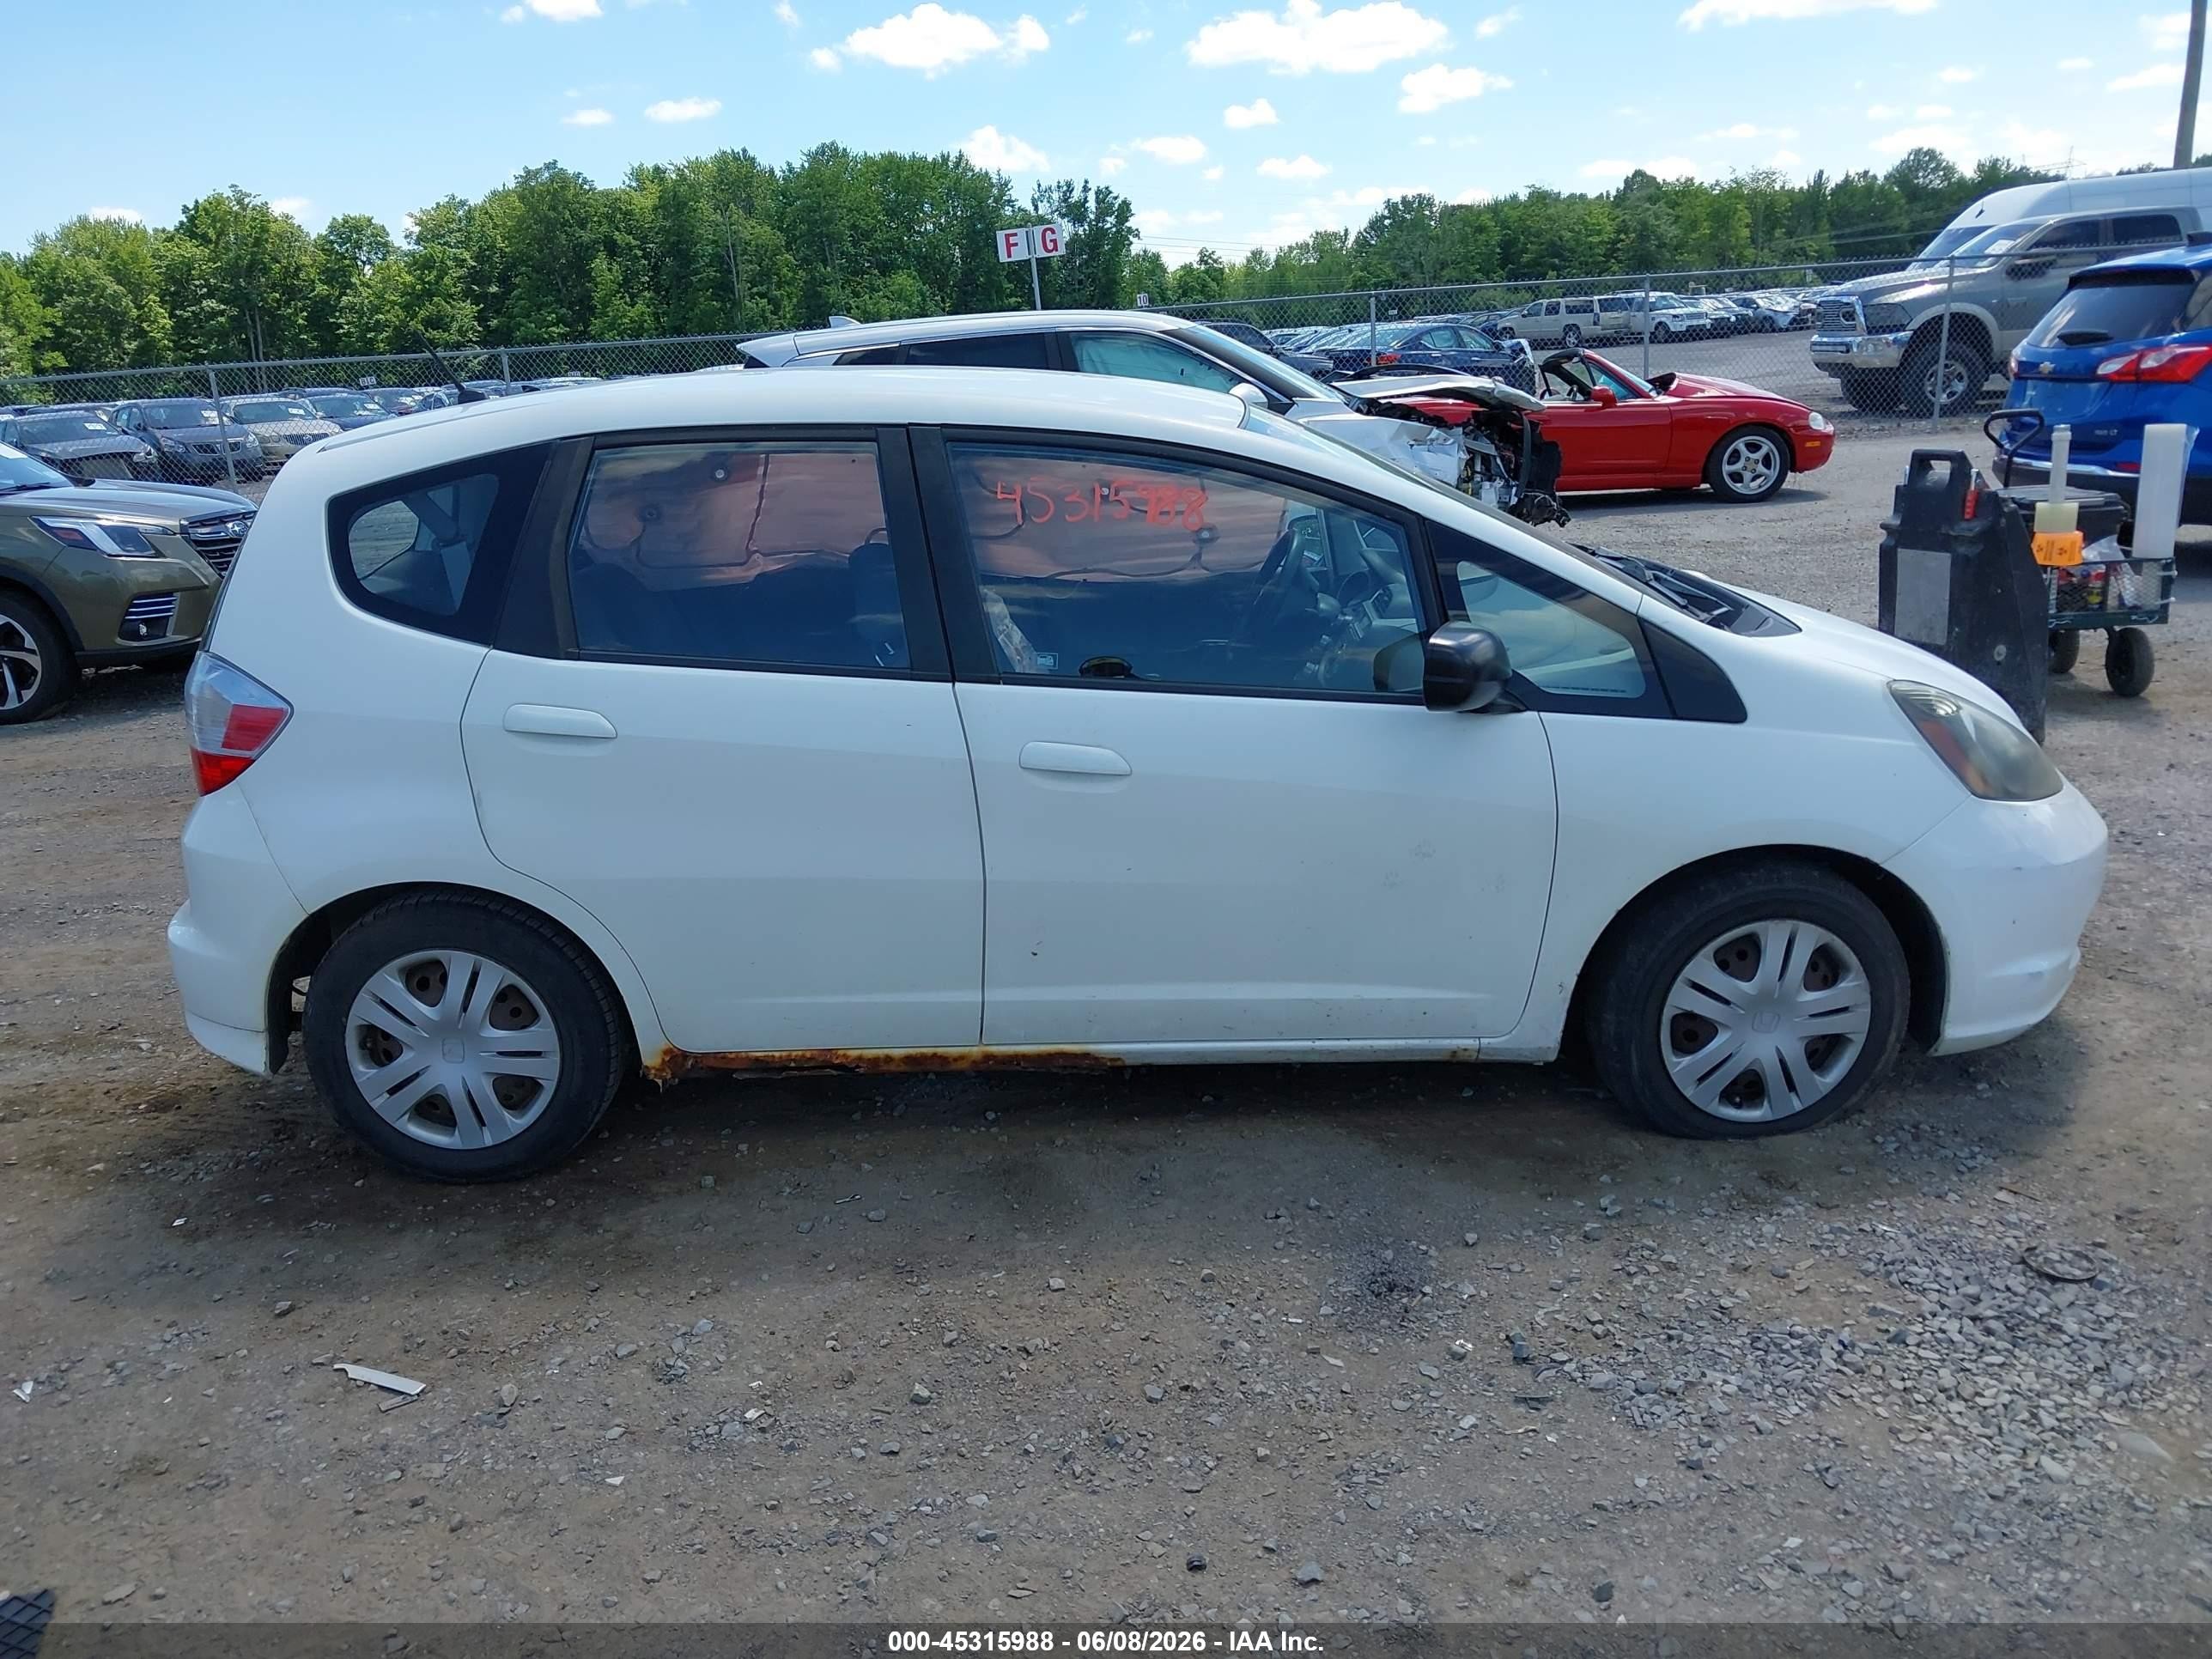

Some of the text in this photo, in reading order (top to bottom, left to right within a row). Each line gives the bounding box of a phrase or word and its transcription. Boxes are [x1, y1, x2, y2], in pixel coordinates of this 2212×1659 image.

[1004, 227, 1059, 258] F G
[1138, 295, 1148, 306] 10
